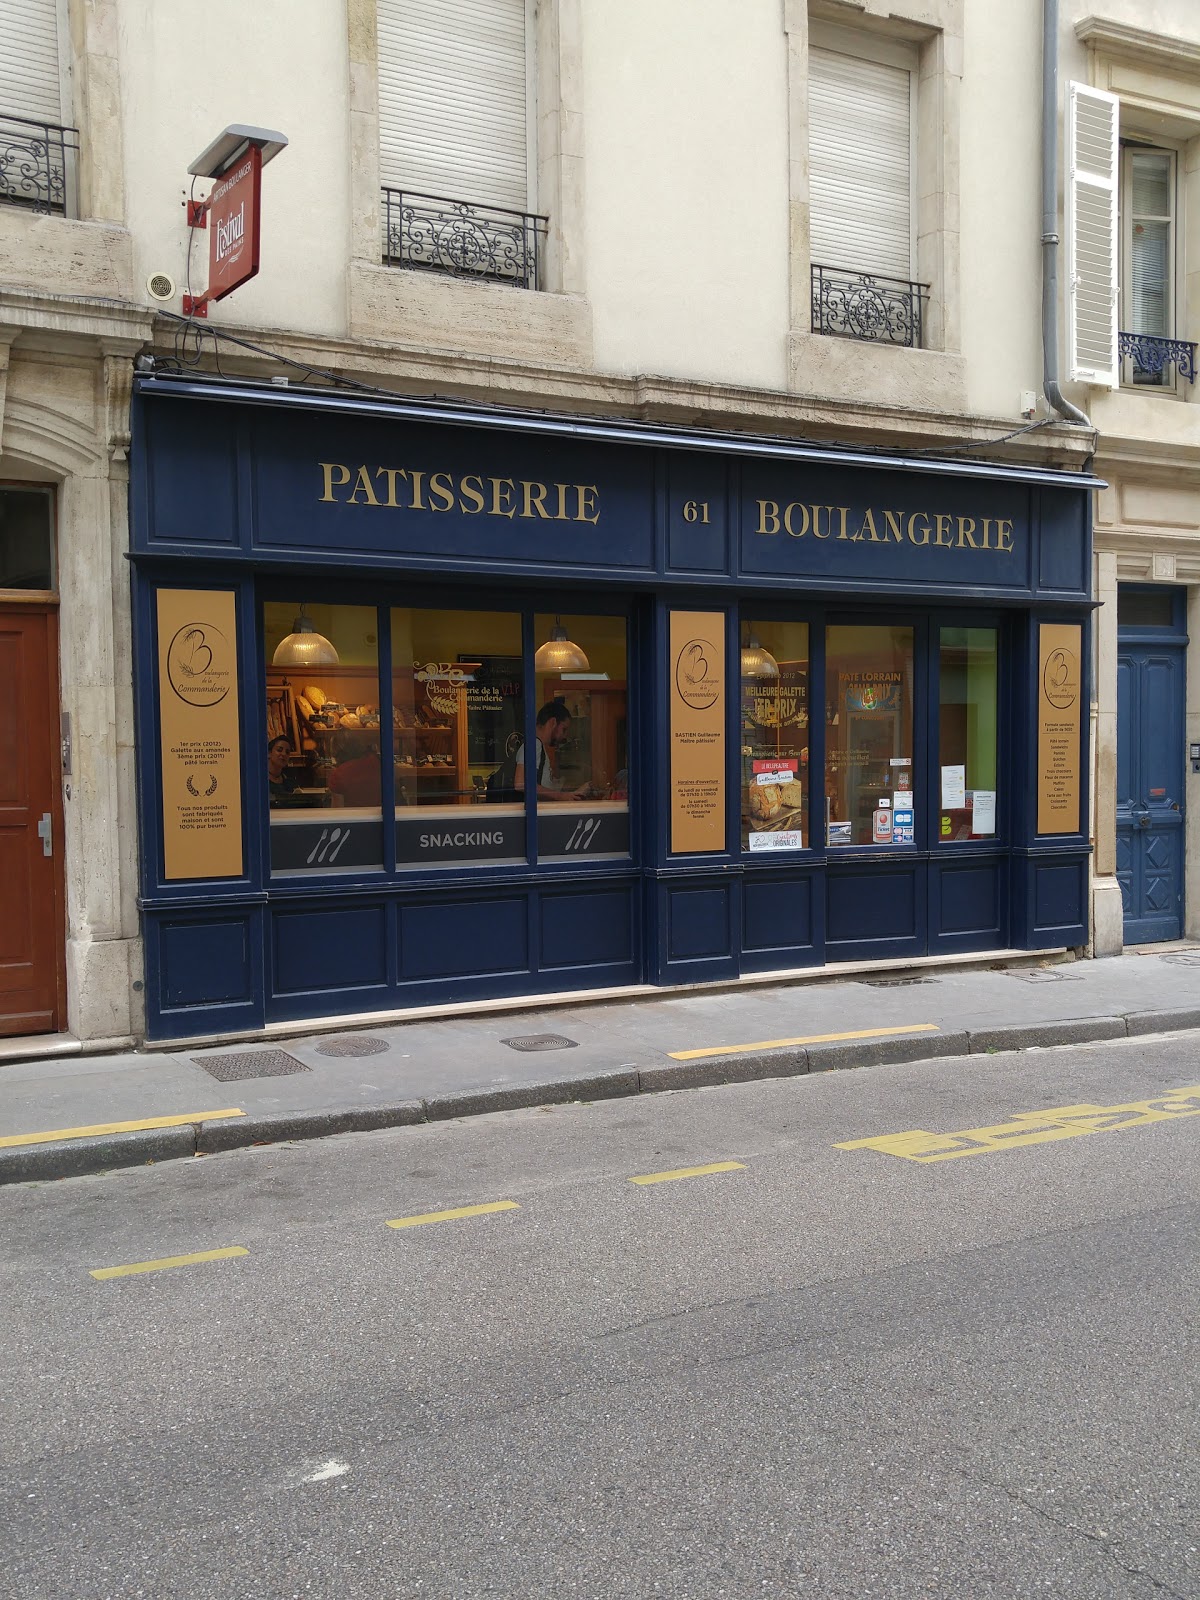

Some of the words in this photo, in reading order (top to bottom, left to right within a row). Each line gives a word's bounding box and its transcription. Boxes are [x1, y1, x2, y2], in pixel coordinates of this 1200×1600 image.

[216, 201, 244, 262] Festival
[318, 462, 600, 525] PATISSERIE
[683, 500, 711, 524] 61
[755, 499, 1014, 552] BOULANGERIE
[861, 672, 901, 681] LORRAIN
[178, 683, 226, 693] Commanderie
[745, 686, 779, 697] MEILLEURE
[780, 686, 806, 697] GALETTE
[774, 698, 797, 720] PRIX
[420, 831, 504, 848] SNACKING
